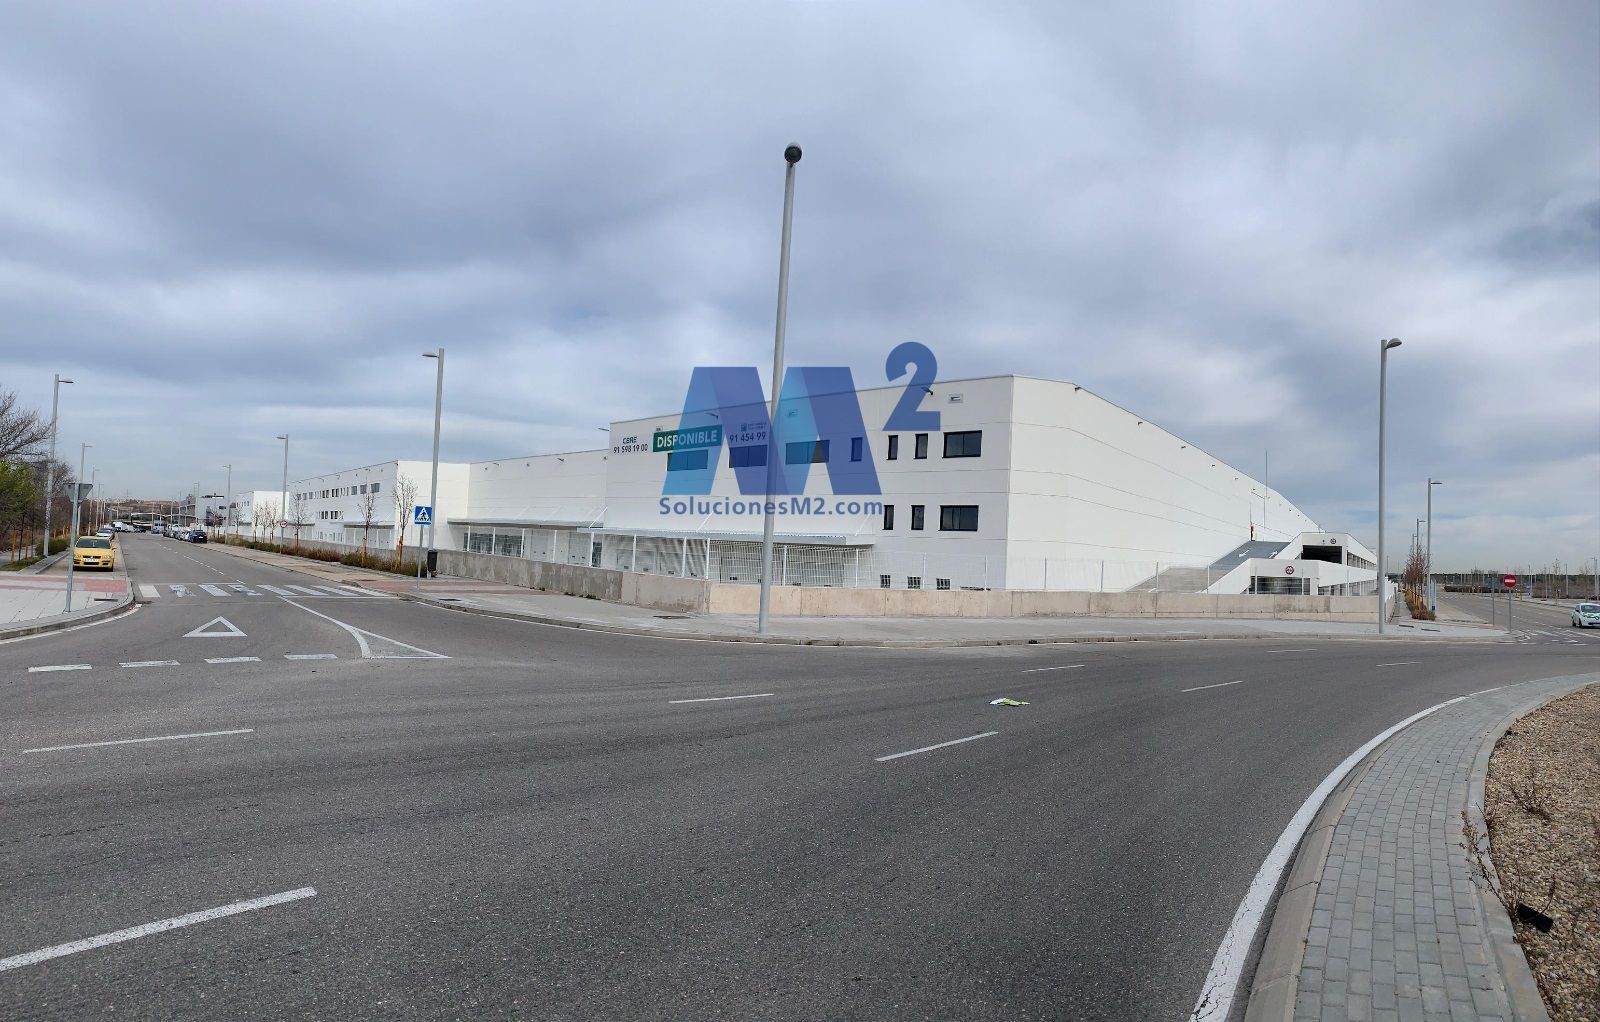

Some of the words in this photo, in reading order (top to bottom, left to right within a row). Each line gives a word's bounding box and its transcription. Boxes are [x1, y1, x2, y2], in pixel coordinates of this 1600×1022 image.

[657, 429, 718, 448] DISPONIBLE
[729, 434, 738, 443] 91
[740, 433, 754, 442] 454
[613, 446, 620, 454] 91
[621, 445, 632, 453] 598
[633, 444, 640, 452] 19
[640, 443, 649, 452] 00
